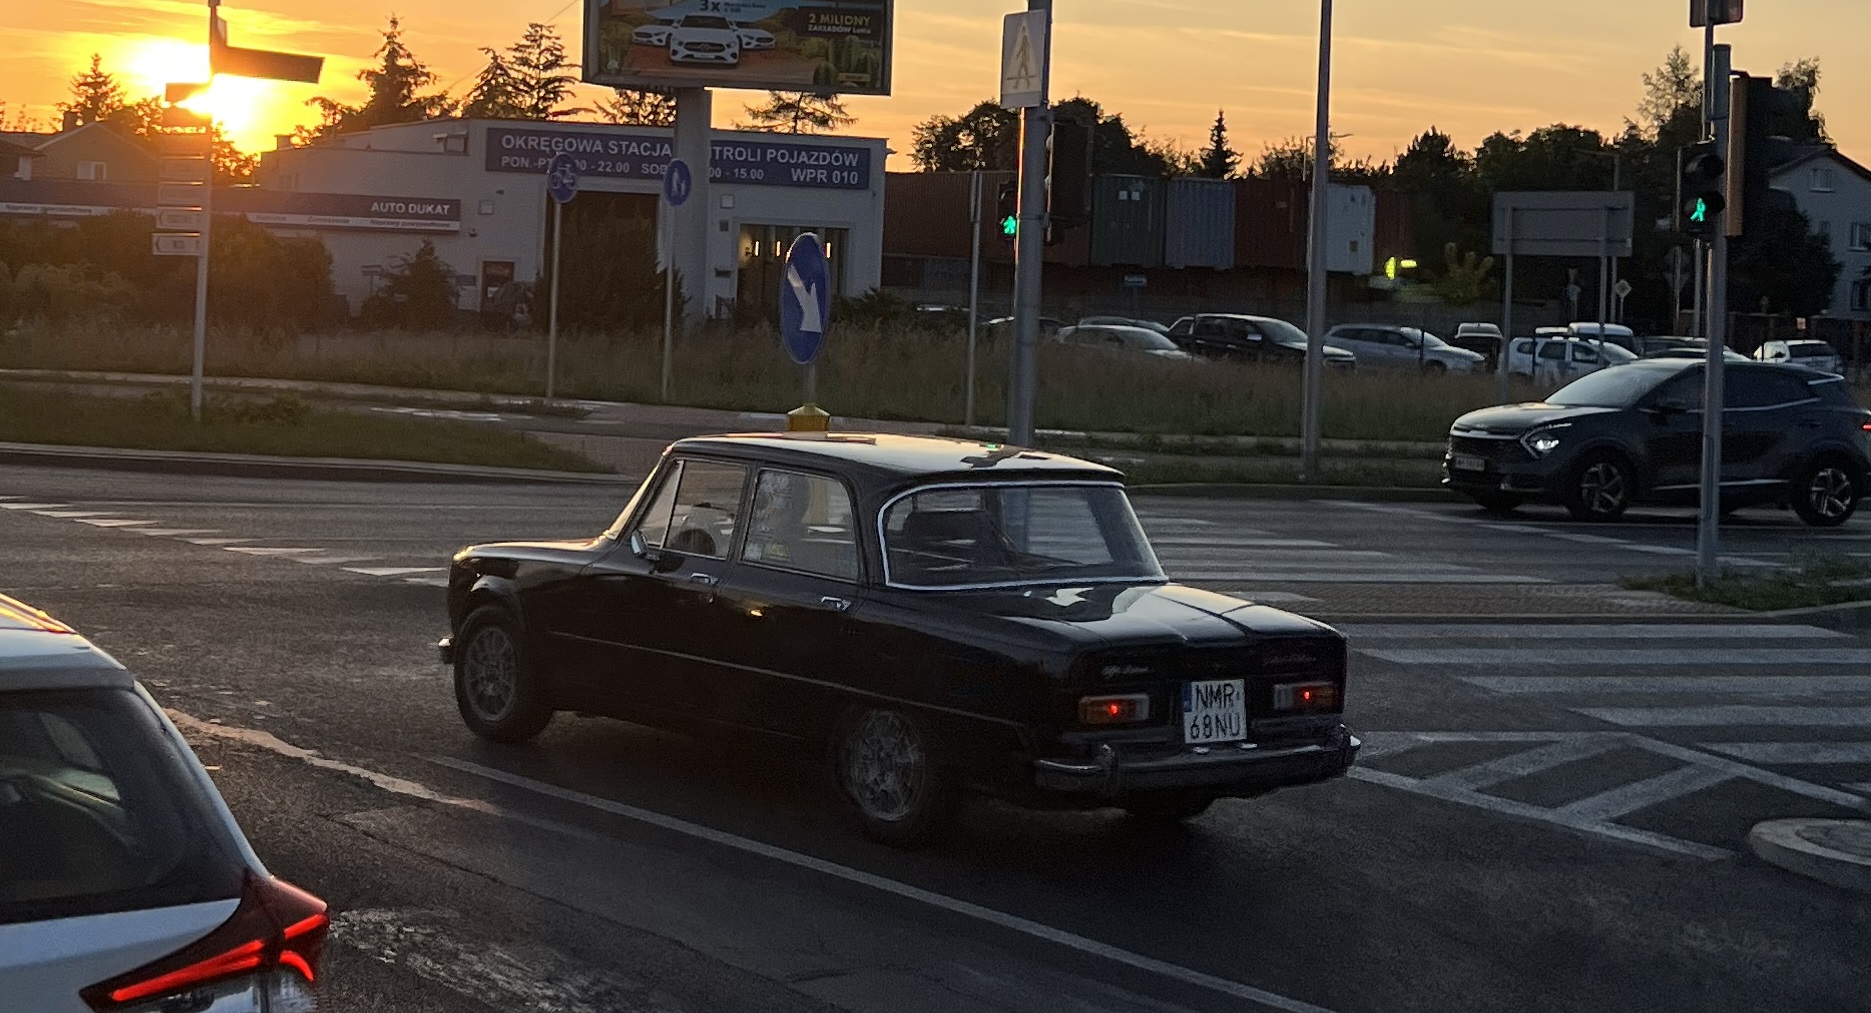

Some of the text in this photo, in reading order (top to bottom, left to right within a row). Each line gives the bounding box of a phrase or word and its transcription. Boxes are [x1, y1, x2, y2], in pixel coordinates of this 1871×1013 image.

[699, 0, 709, 11] 3
[808, 13, 871, 26] 2 MILIONY
[501, 135, 859, 167] OKRĘGOWA STACJA TROLI POJAZDÓW
[598, 161, 630, 173] 22.00
[733, 168, 765, 180] 15.00
[791, 168, 828, 183] WPR
[832, 170, 859, 185] 010
[371, 202, 450, 215] AUTO DUKAT
[1195, 683, 1235, 709] NMR
[1190, 713, 1240, 740] 68NU
